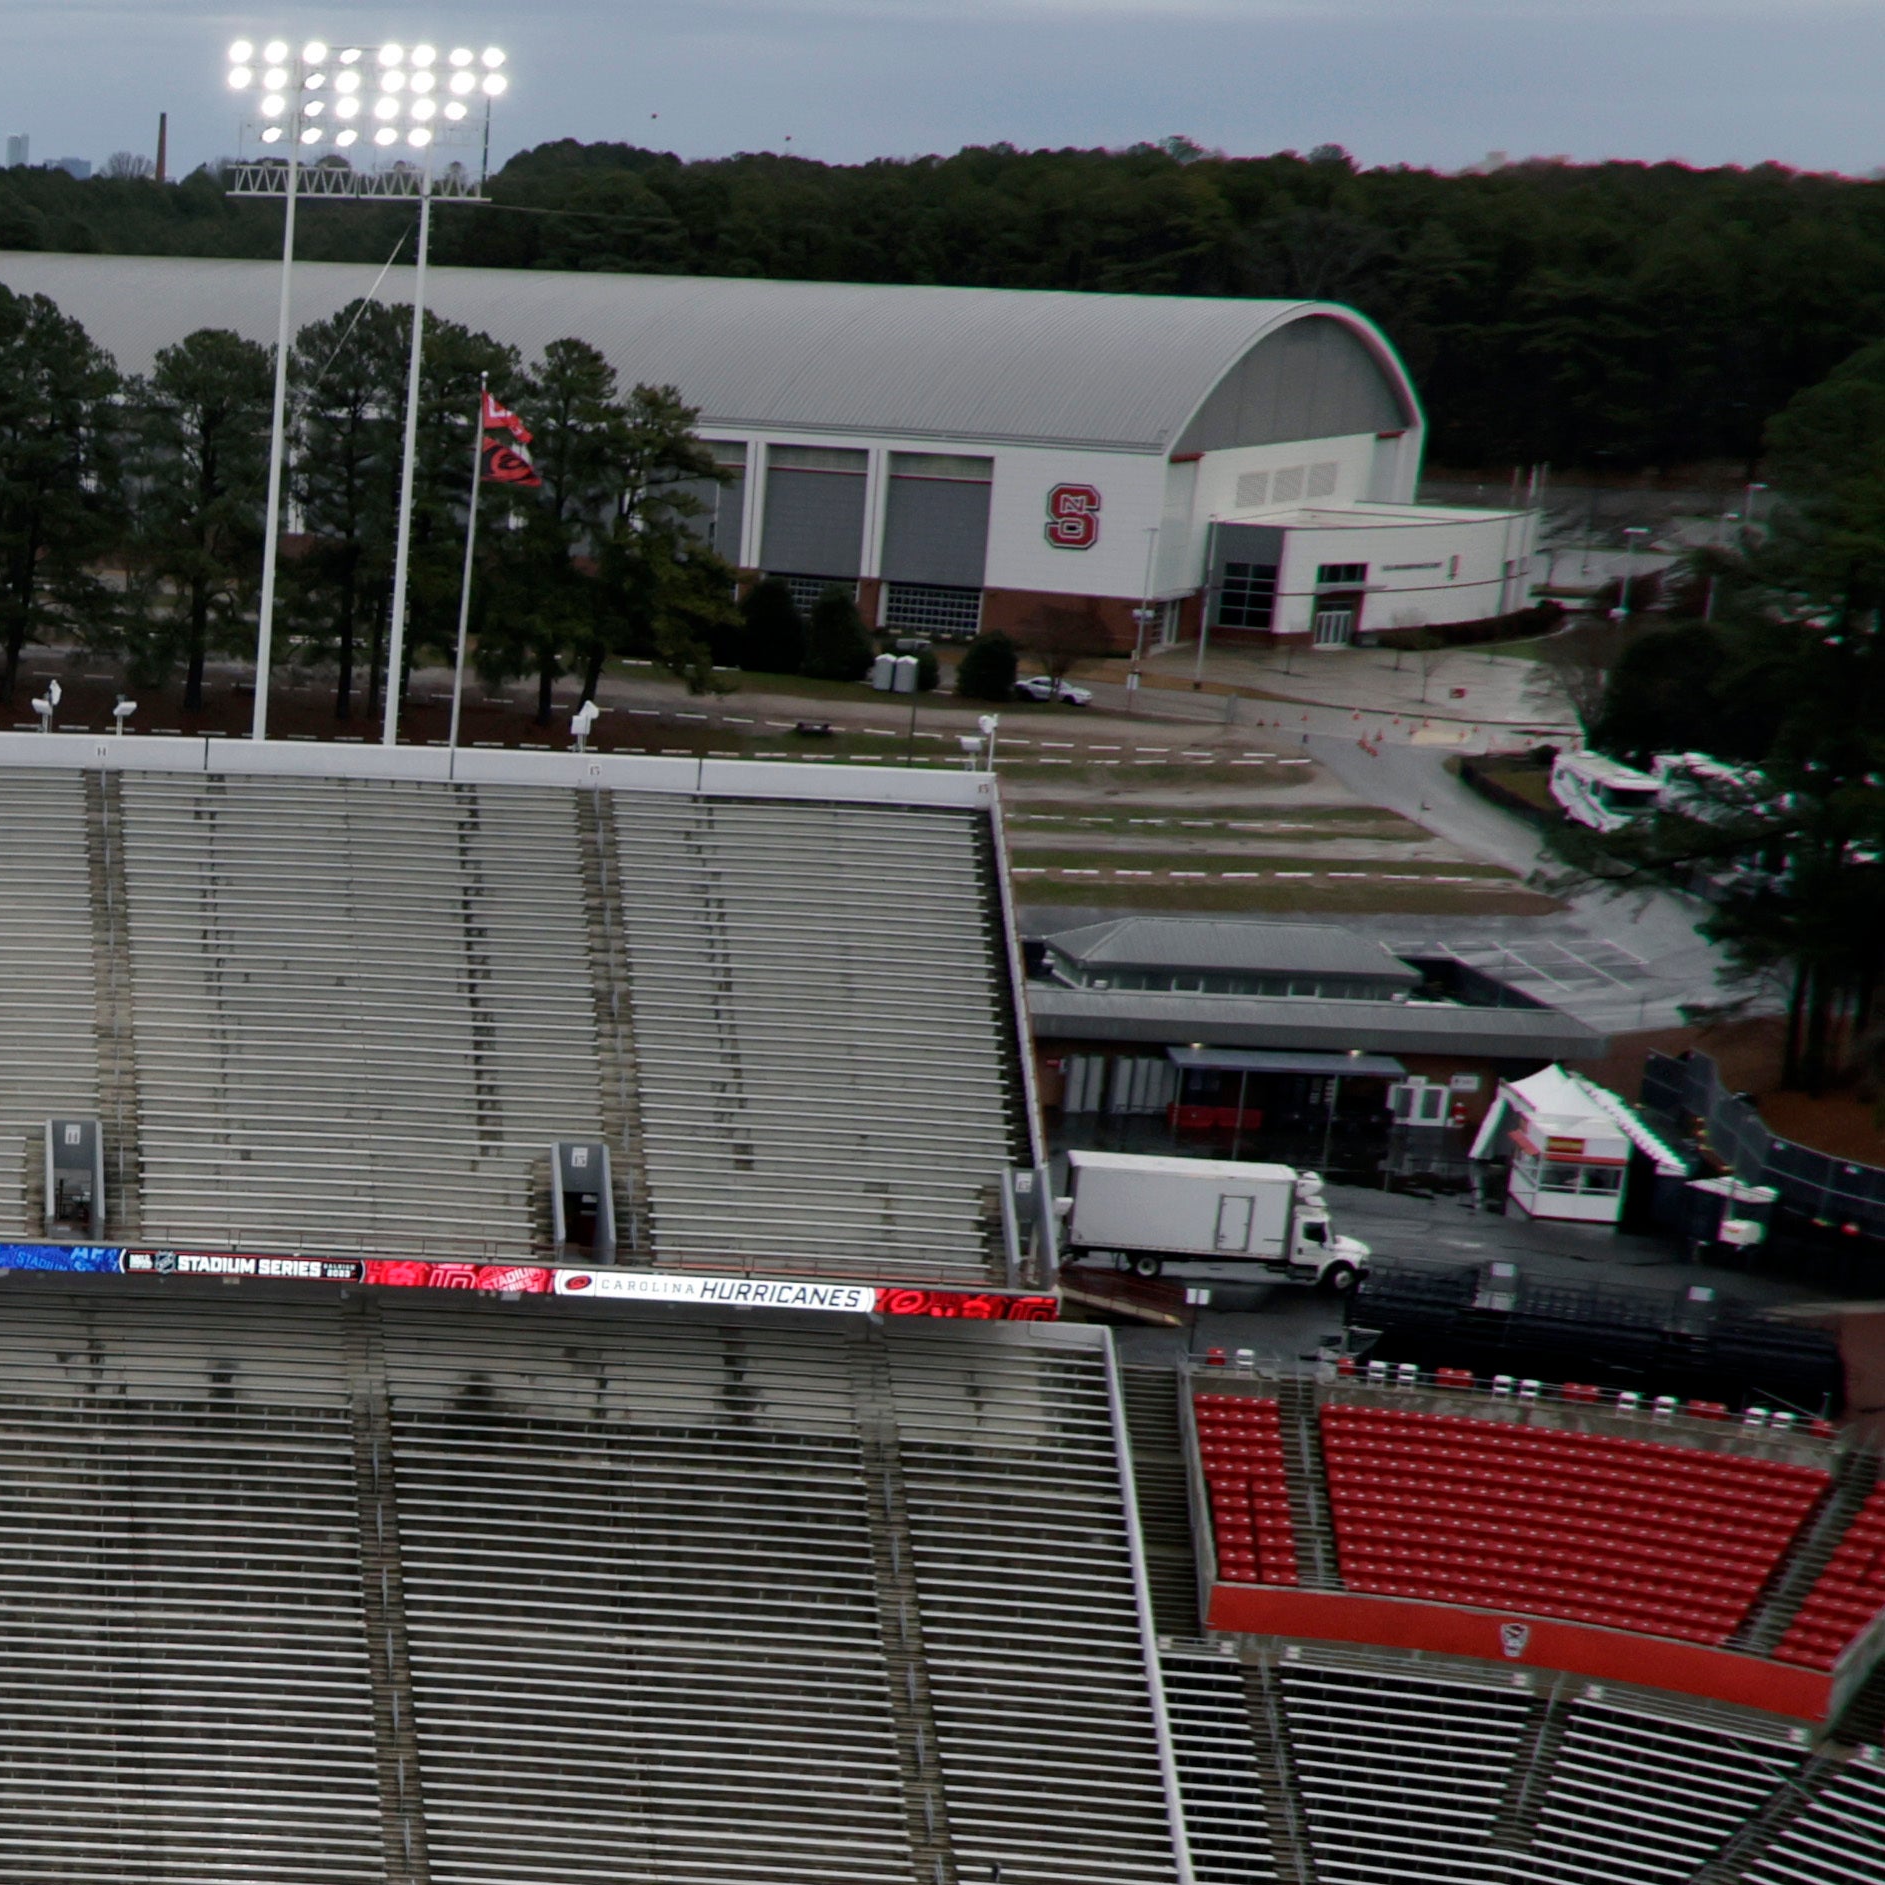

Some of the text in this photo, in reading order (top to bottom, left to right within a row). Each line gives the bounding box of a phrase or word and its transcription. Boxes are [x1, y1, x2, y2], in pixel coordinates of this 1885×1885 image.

[178, 1255, 255, 1274] STADIUM
[258, 1259, 321, 1277] SERIES
[327, 1269, 352, 1278] 2023
[601, 1279, 862, 1308] CAROLINA HURRICANES
